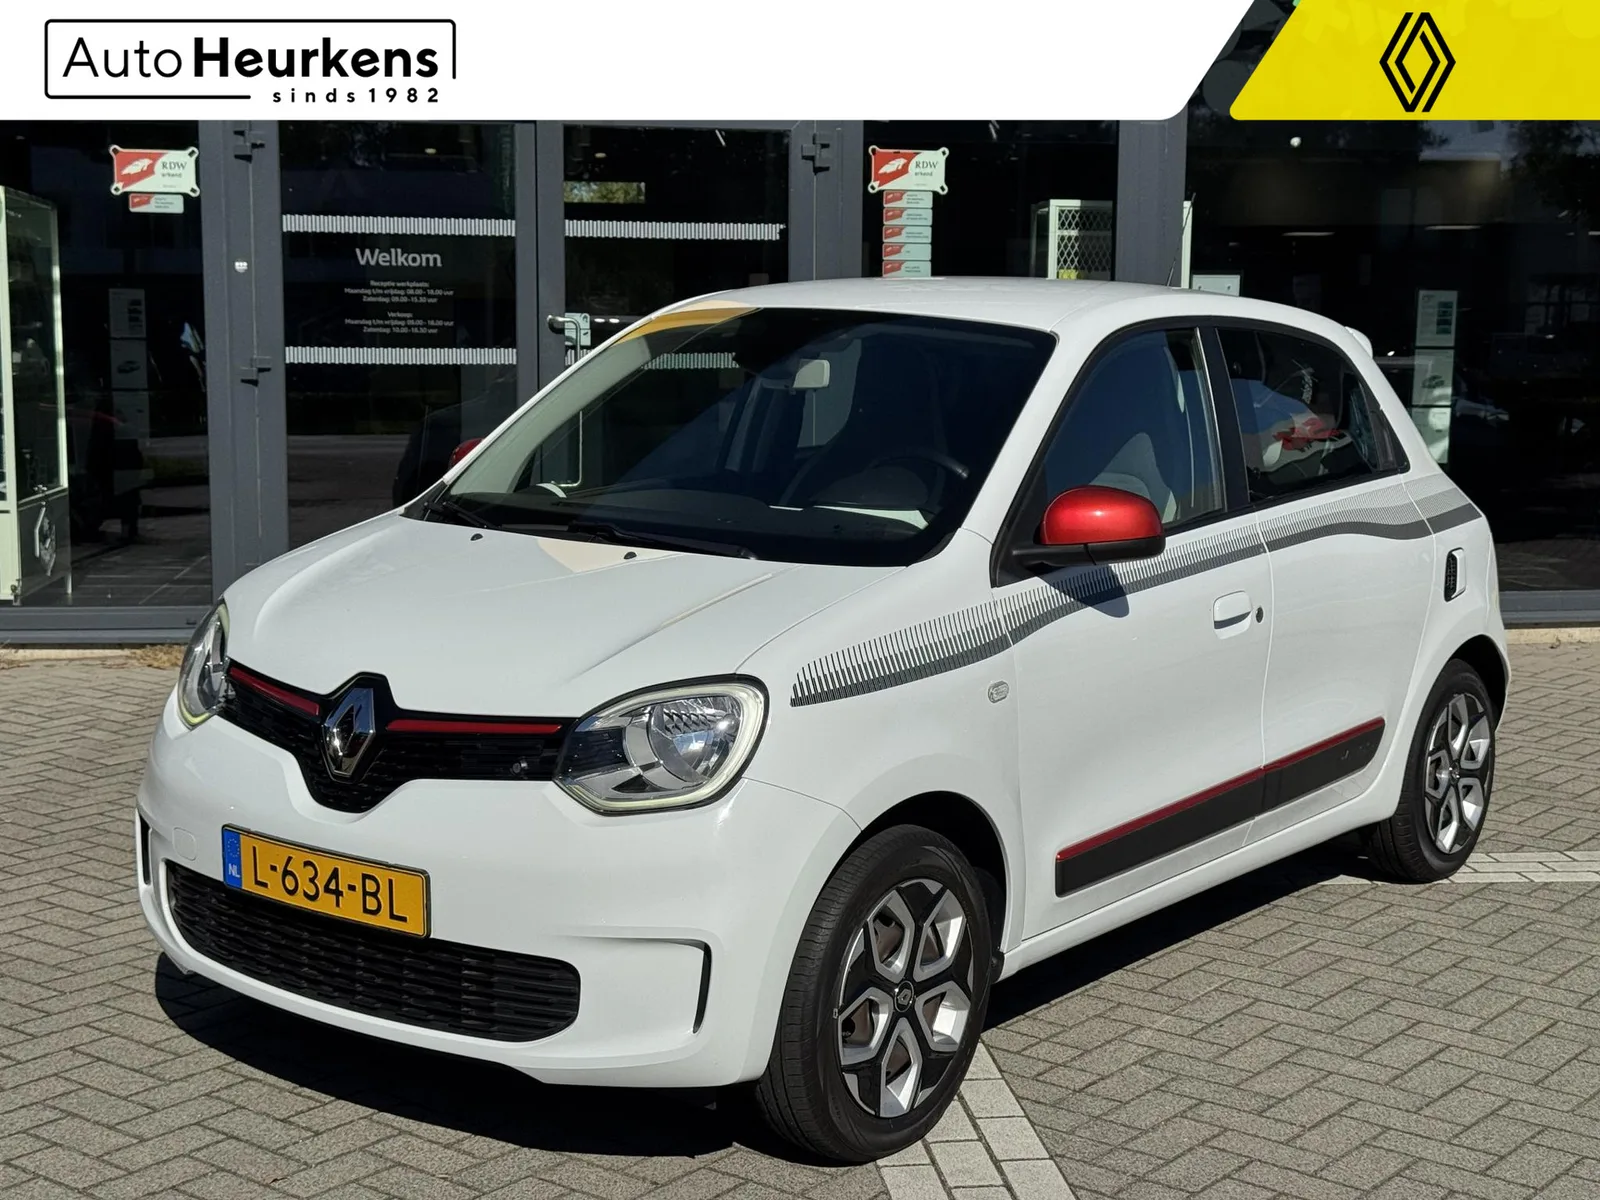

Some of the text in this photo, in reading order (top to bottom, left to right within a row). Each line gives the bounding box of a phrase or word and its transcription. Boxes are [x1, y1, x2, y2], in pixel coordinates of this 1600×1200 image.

[161, 161, 187, 170] RDW
[915, 160, 939, 169] RDW
[355, 247, 443, 267] Welkom
[345, 318, 372, 326] Maandag
[228, 863, 241, 878] NL
[252, 846, 408, 923] L-634-BL
